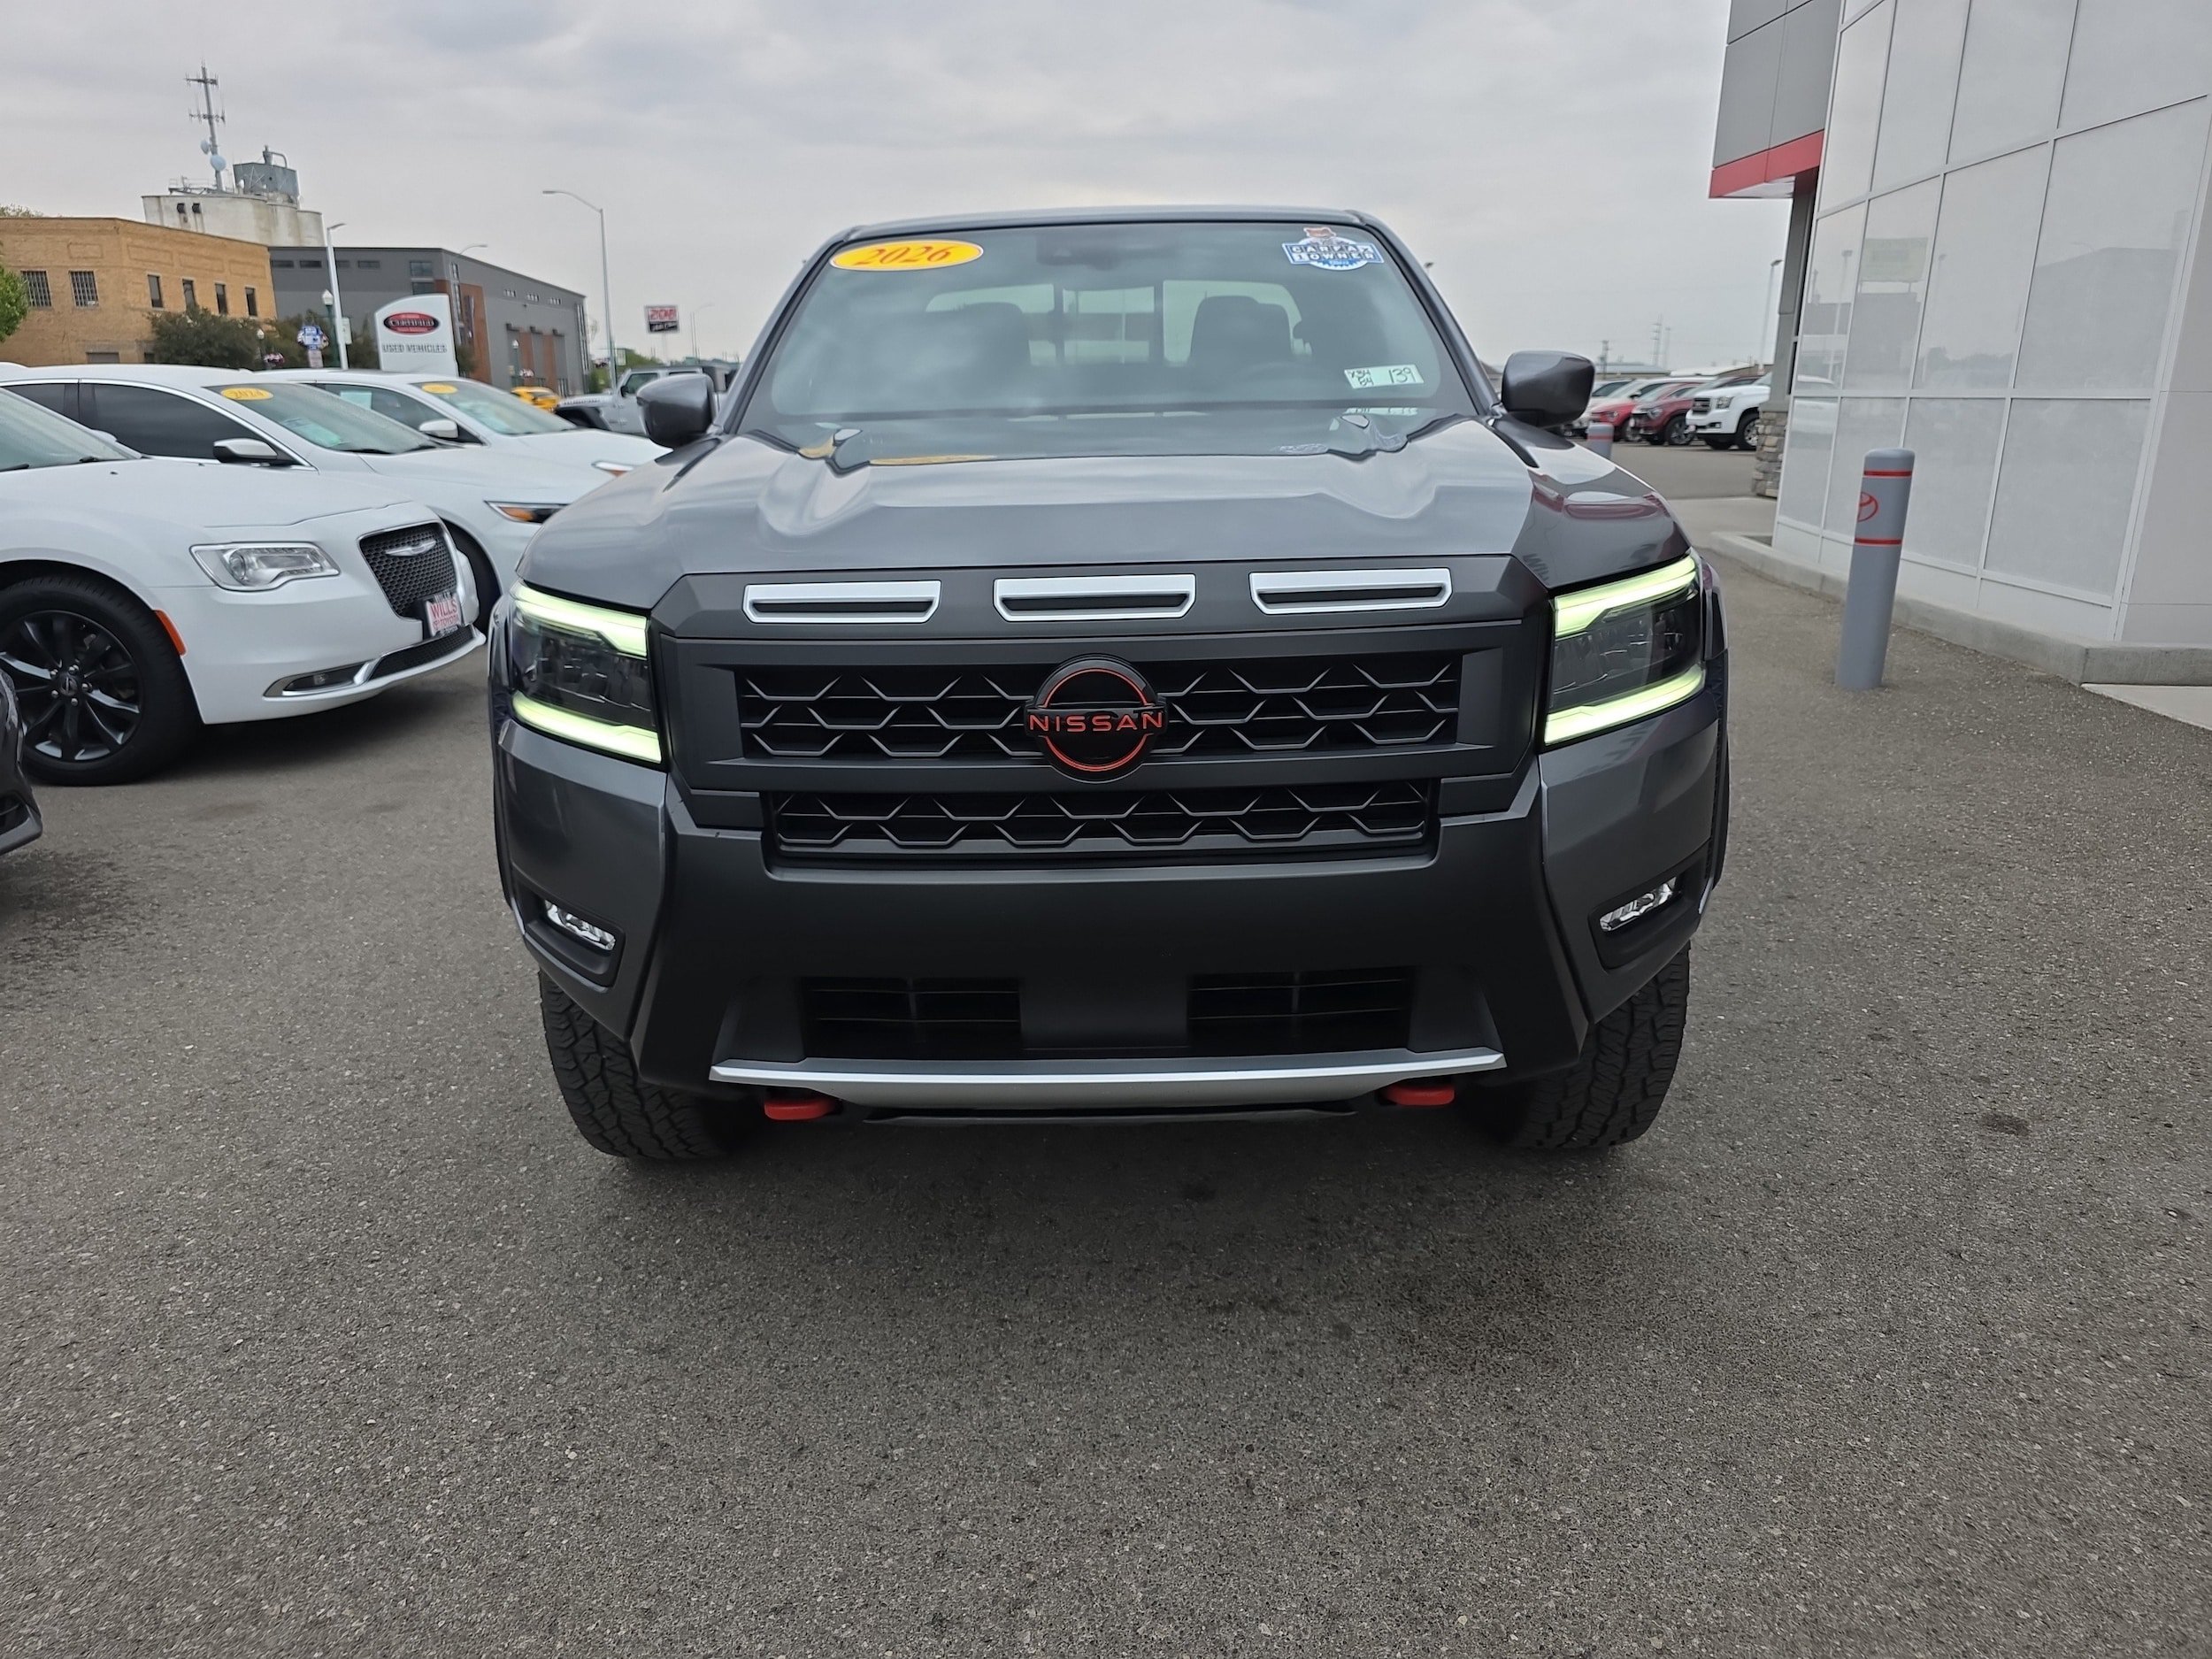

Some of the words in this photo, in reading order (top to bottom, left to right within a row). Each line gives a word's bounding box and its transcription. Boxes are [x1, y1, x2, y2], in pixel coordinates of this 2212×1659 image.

[852, 245, 957, 265] 2026
[382, 344, 405, 353] USED
[407, 344, 448, 353] VEHICLES
[1388, 367, 1417, 384] 139
[430, 598, 457, 618] WILLS
[1028, 710, 1164, 733] NISSAN
